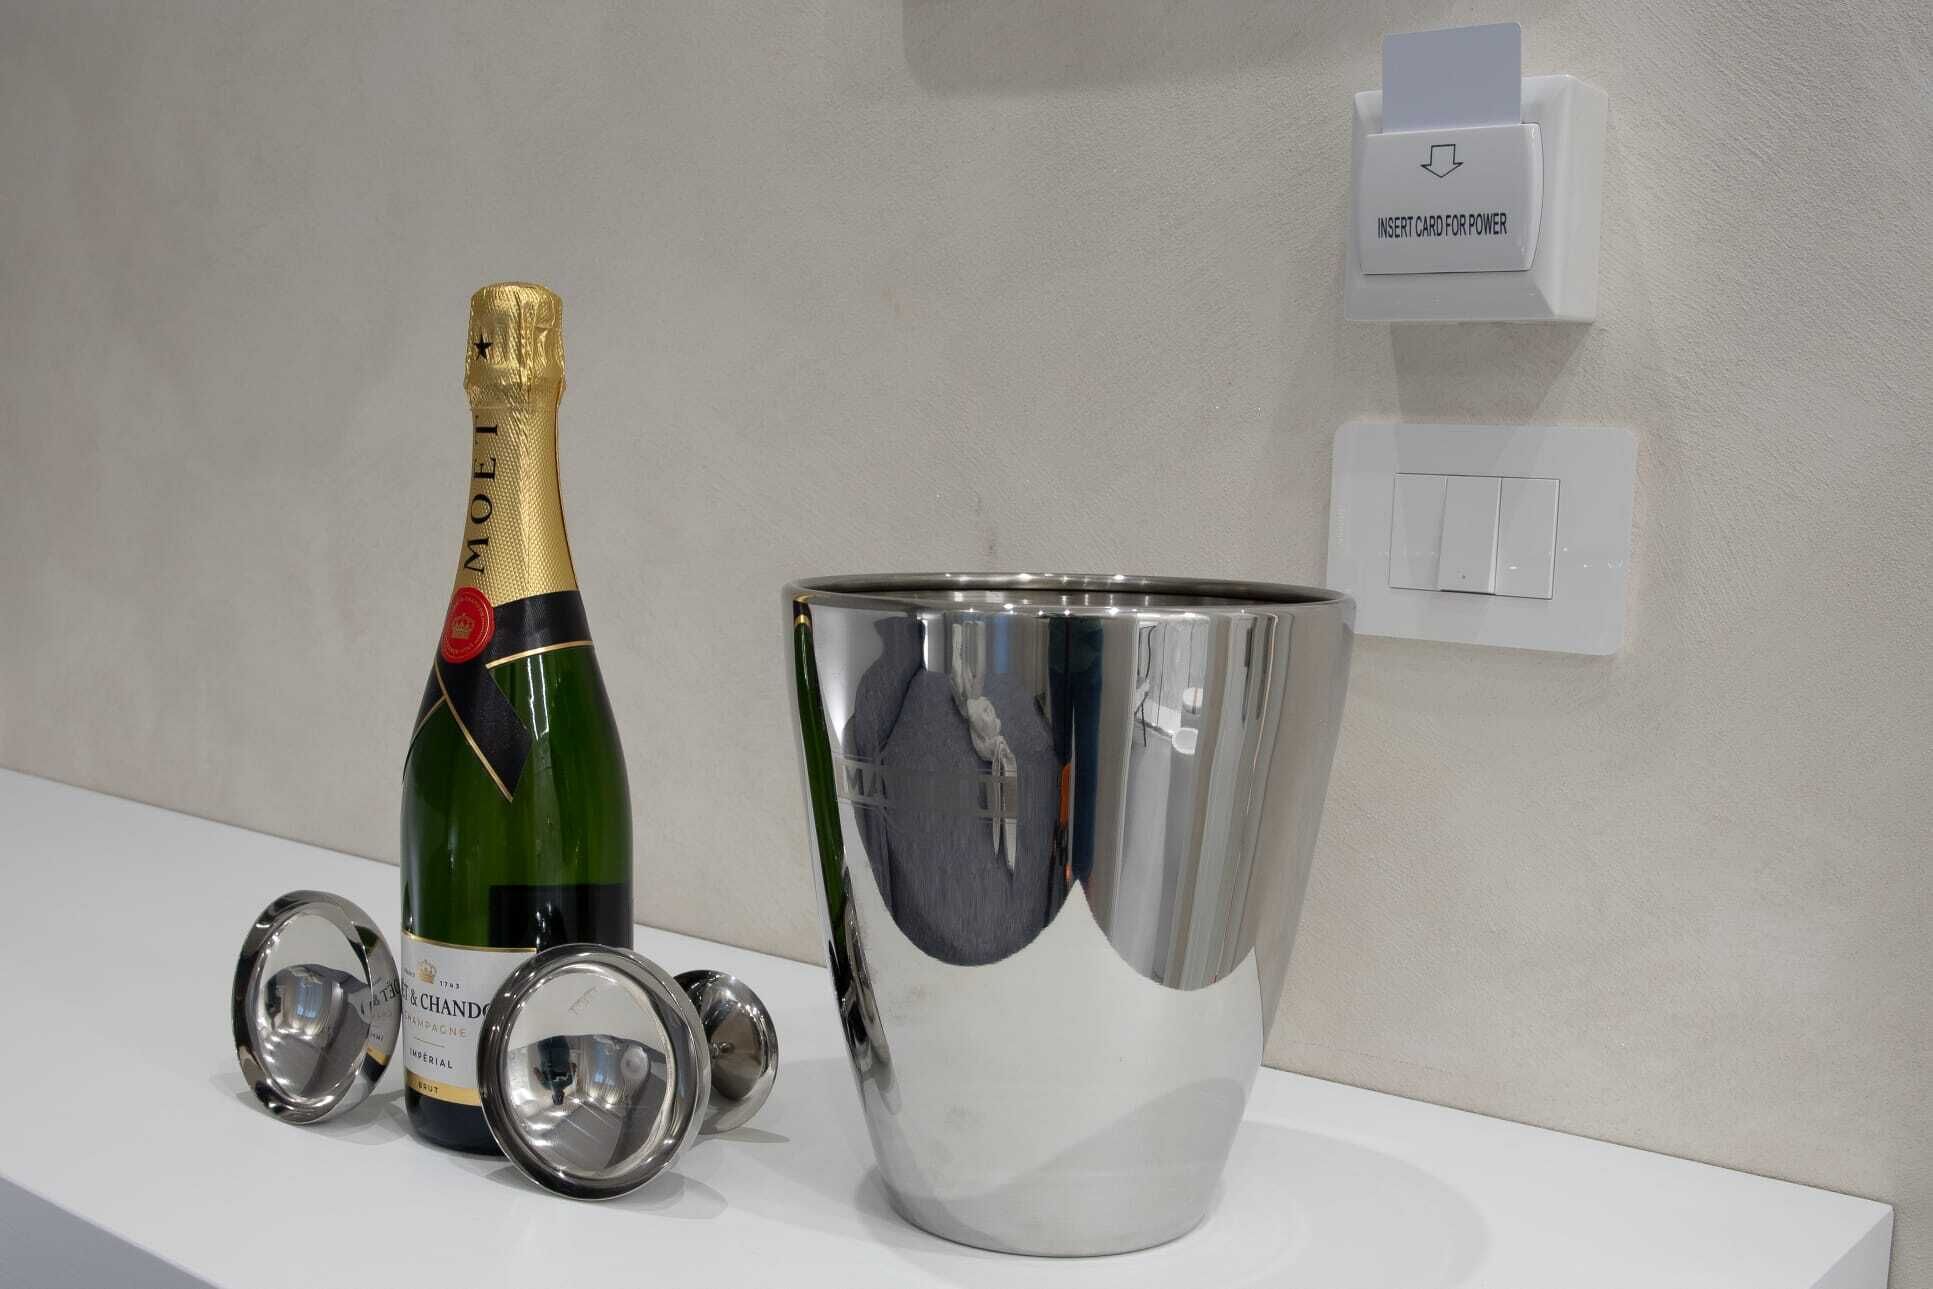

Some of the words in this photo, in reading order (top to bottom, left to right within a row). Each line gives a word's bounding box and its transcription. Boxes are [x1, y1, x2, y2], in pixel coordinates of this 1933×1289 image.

[1378, 216, 1413, 239] INSERT
[1415, 215, 1443, 238] CARD
[1445, 214, 1466, 237] FOR
[1469, 213, 1507, 236] POWER
[410, 988, 417, 1007] &
[417, 1080, 439, 1095] BRUT
